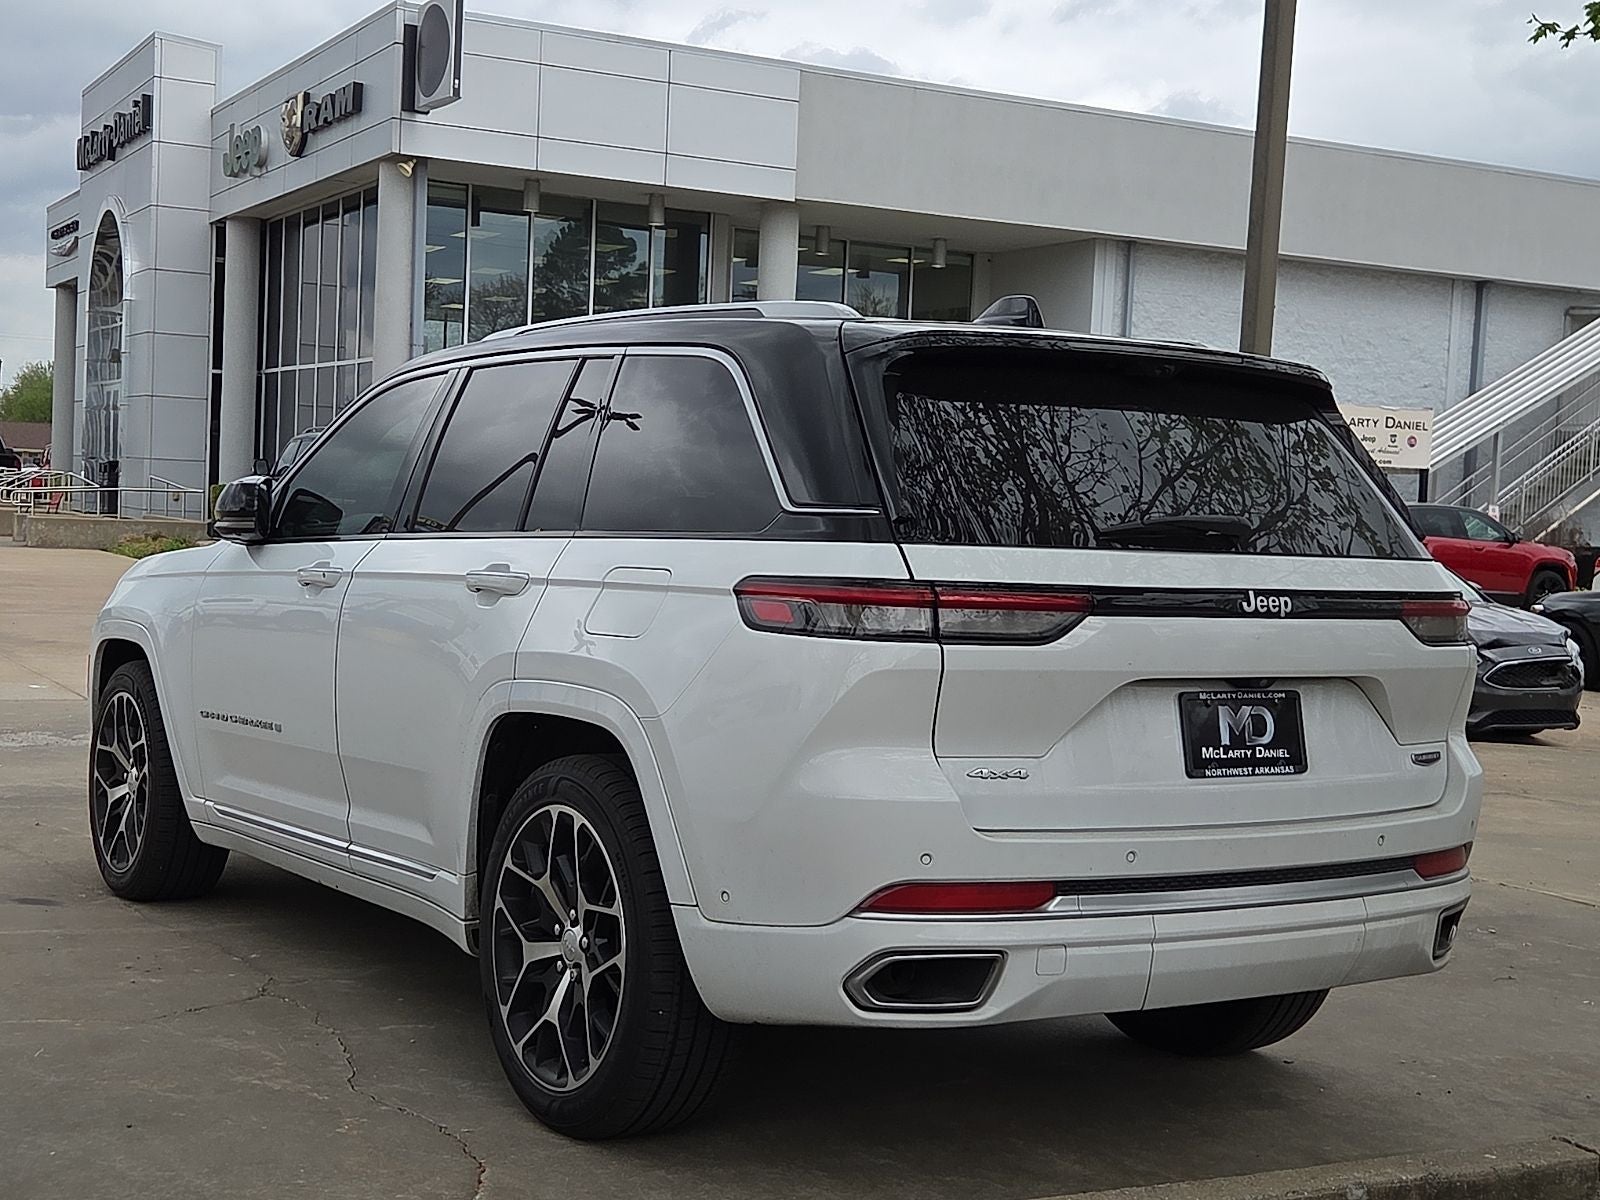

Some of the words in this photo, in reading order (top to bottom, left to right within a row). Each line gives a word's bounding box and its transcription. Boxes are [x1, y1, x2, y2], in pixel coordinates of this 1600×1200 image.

[302, 81, 363, 134] RAM
[222, 123, 268, 178] Jeep
[1348, 417, 1379, 428] ARTY
[1242, 590, 1292, 617] Jeep
[1205, 767, 1253, 777] NORTHWEST
[1254, 765, 1295, 775] ARKANSAS
